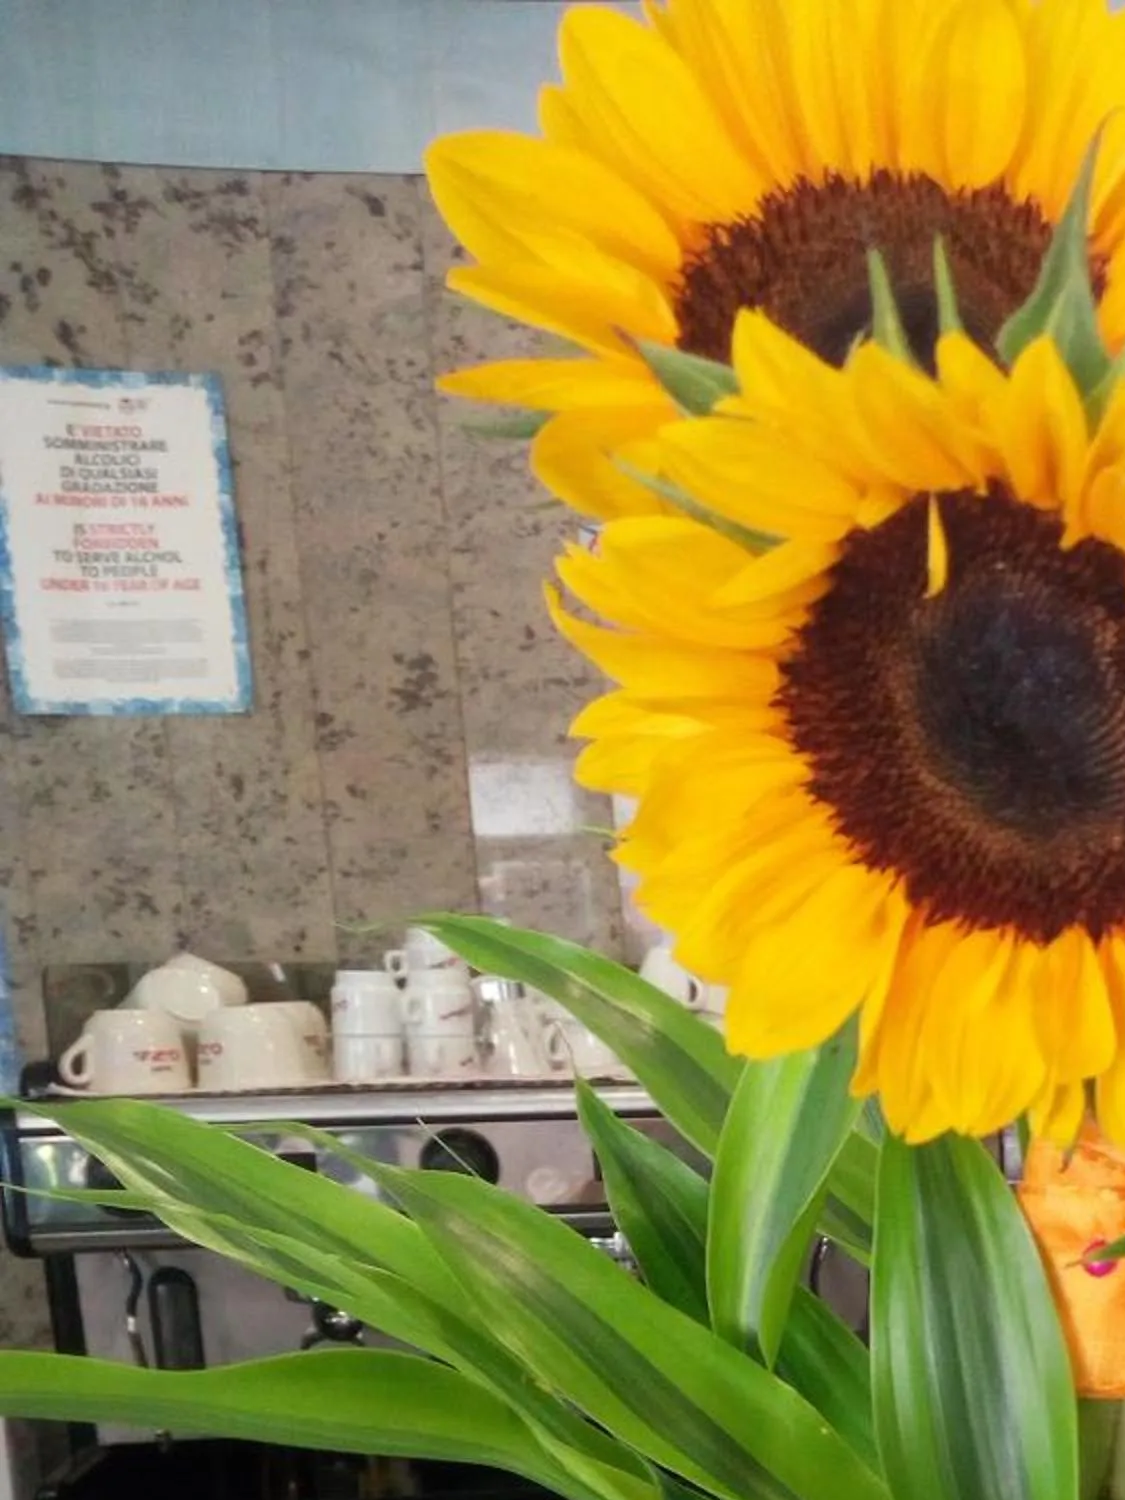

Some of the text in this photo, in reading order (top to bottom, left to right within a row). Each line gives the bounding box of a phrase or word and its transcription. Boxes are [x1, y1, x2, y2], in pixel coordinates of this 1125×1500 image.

[43, 436, 168, 452] SOMMINISTRARE
[60, 465, 158, 480] DI QUALSIASI
[61, 480, 158, 493] GRADAZIONE
[53, 550, 73, 563] TO
[76, 550, 121, 564] SERVE
[80, 565, 158, 578] TO PEOPLE
